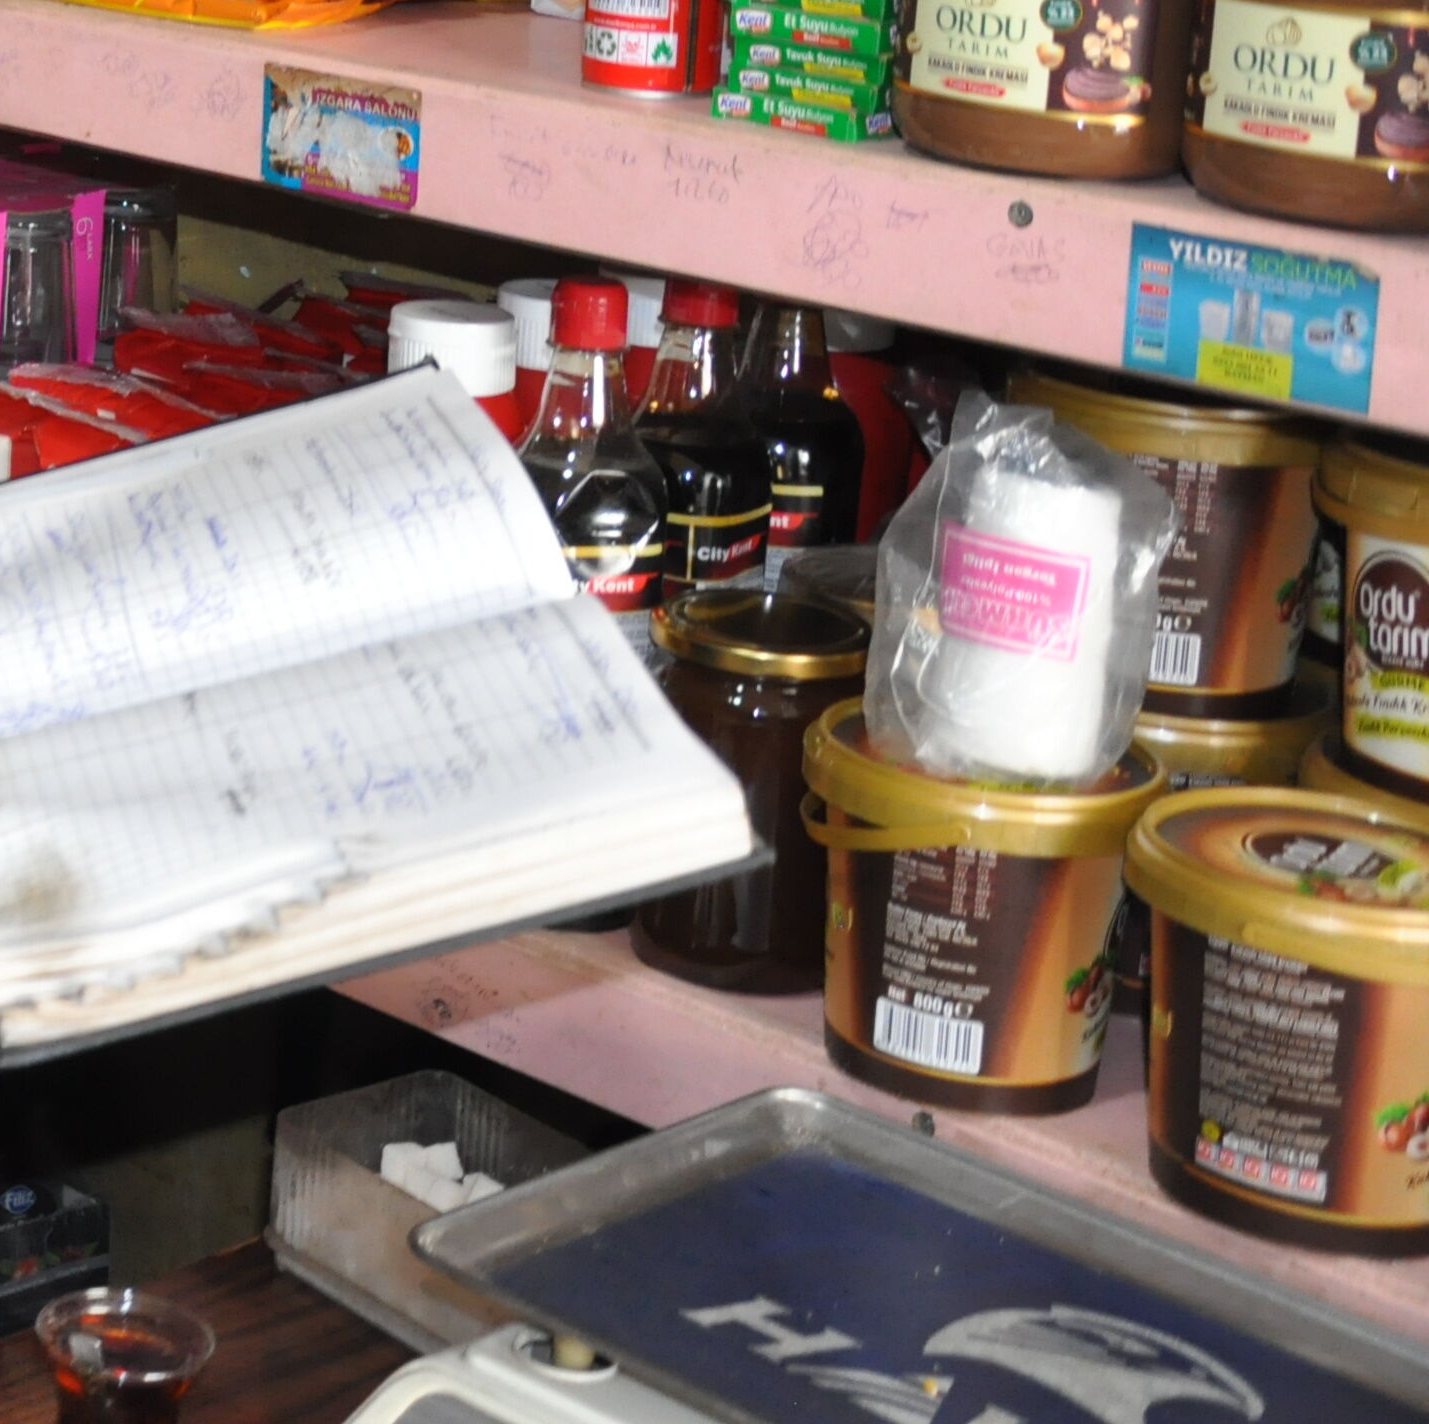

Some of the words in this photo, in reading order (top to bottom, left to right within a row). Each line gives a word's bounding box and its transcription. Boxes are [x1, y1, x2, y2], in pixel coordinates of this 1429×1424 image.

[738, 13, 770, 27] Kent
[785, 13, 796, 26] Et
[800, 15, 829, 32] Suyu
[937, 5, 1027, 43] ORDU
[752, 47, 778, 60] Kent
[787, 48, 814, 61] Tavuk
[817, 51, 842, 67] Suyu
[948, 38, 1009, 59] TARIM
[1234, 45, 1335, 85] ORDU
[742, 73, 768, 86] Kent
[775, 74, 802, 87] Tavuk
[805, 77, 830, 92] Suyu
[1246, 81, 1314, 103] TARIM
[364, 99, 419, 122] SALONU
[720, 95, 749, 110] Kent
[763, 98, 775, 113] Et
[778, 100, 806, 118] Suyu
[1169, 238, 1248, 269] YILDIZ
[697, 545, 730, 563] City
[594, 578, 635, 594] Kent
[1360, 582, 1417, 625] Ordu
[5, 1189, 36, 1213] Filiz
